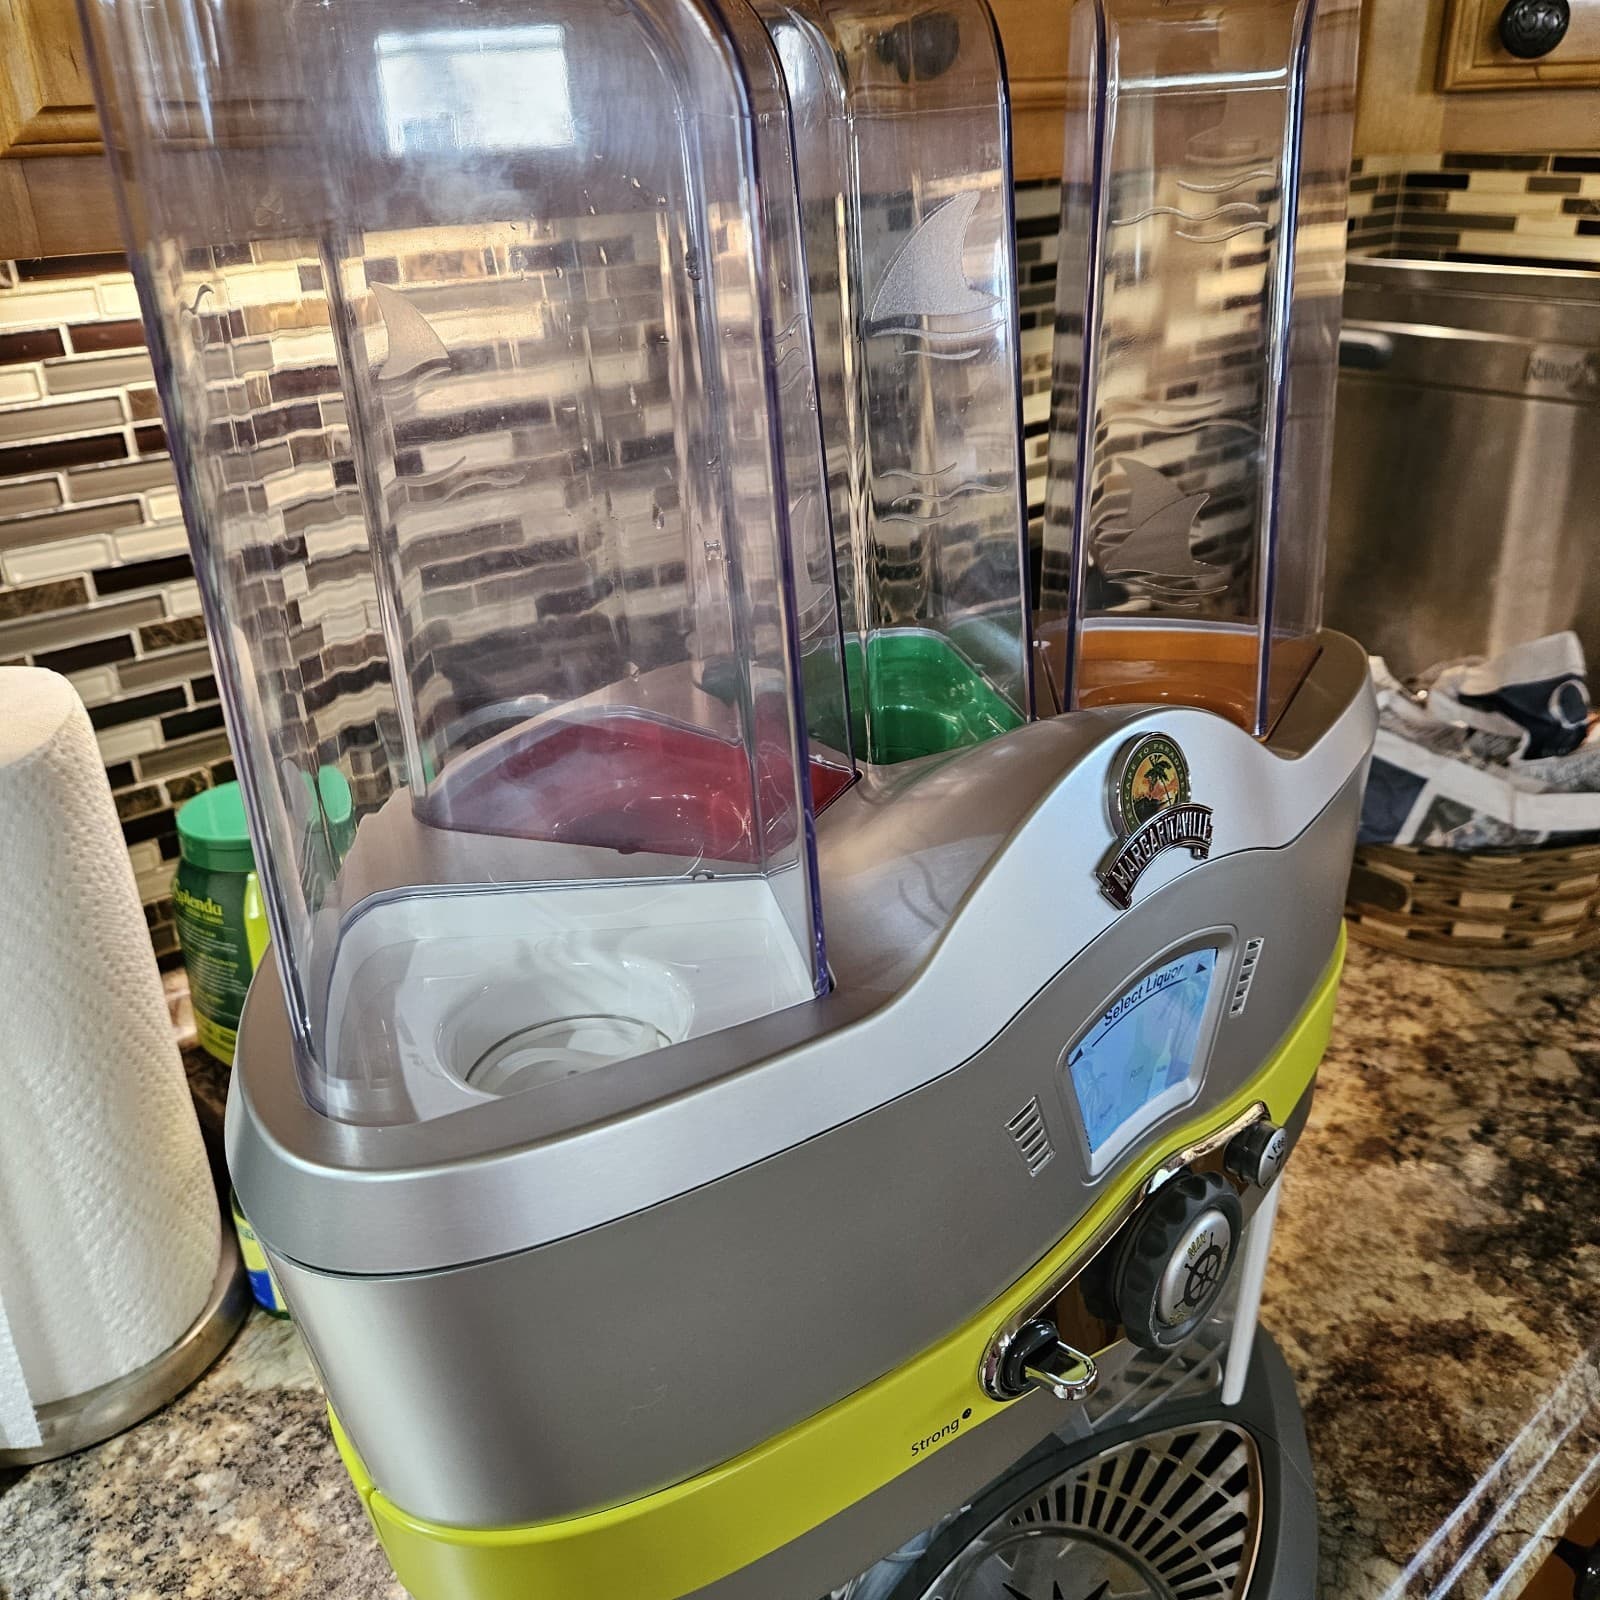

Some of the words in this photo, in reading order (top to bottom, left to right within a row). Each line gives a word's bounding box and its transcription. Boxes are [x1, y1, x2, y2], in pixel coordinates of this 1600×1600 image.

[1111, 810, 1213, 891] MARGARITAVILLE
[1104, 988, 1143, 1027] Select
[1145, 963, 1185, 994] Liquor
[911, 1418, 960, 1457] Strong
